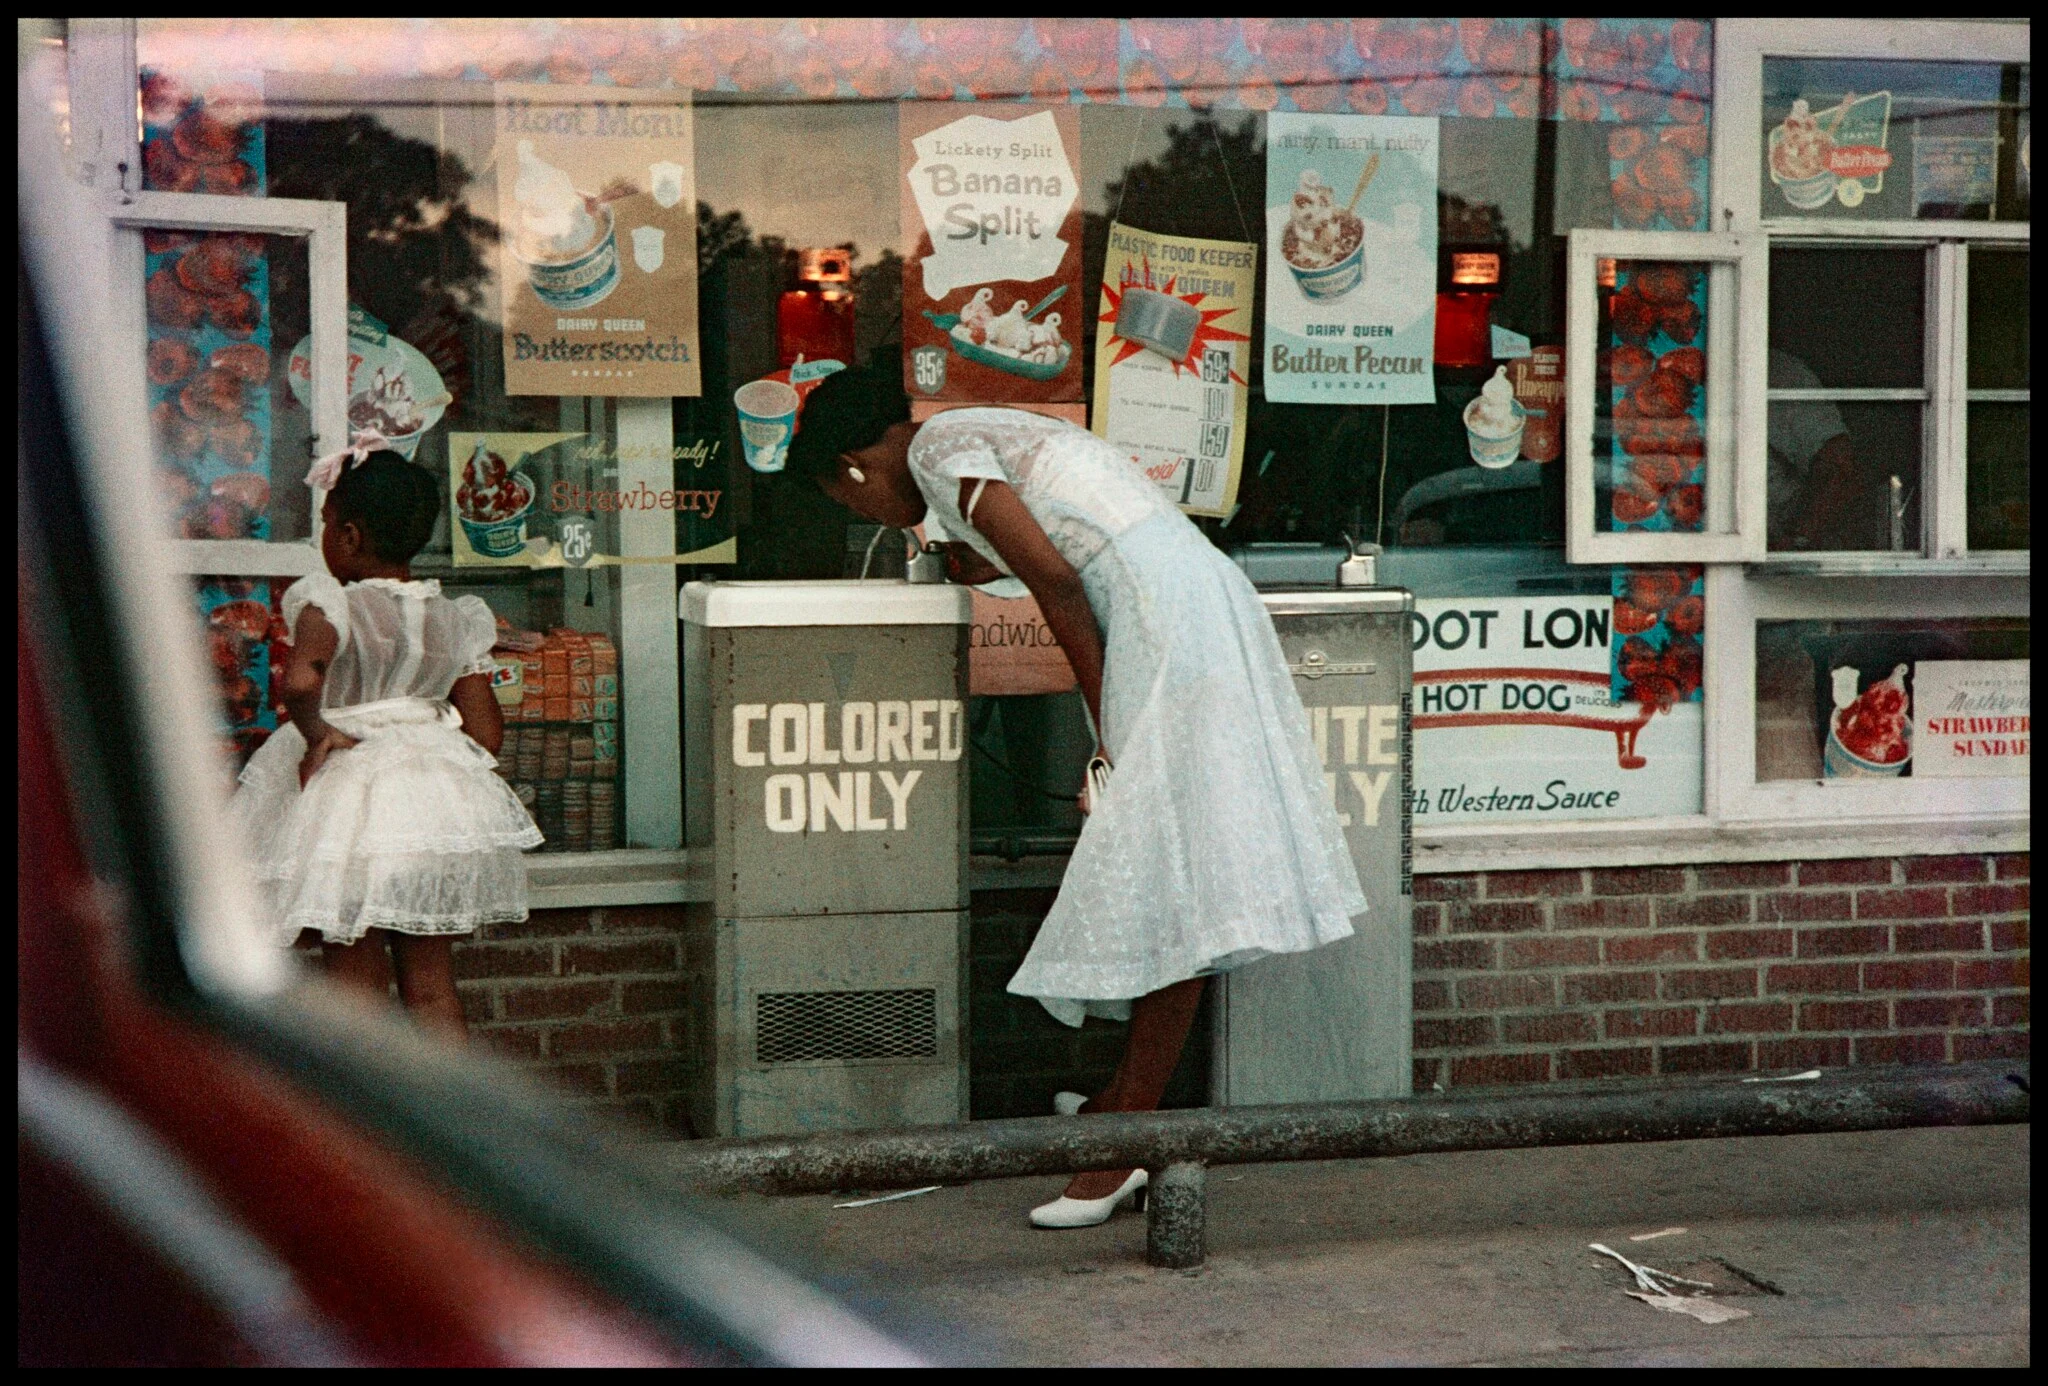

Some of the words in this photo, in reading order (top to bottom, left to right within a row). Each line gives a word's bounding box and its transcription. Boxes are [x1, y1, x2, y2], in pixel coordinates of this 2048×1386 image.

[935, 141, 1004, 160] Lickety
[1009, 142, 1053, 160] Split
[923, 163, 1062, 197] Banana
[945, 203, 1041, 245] Split
[1111, 232, 1158, 259] PLASTIC
[1162, 244, 1196, 263] FOOD
[1201, 248, 1254, 269] KEEPER
[1177, 277, 1236, 298] QUEEN
[556, 318, 598, 331] DAIRY
[603, 318, 646, 332] QUEEN
[1306, 324, 1346, 337] DAIRY
[1353, 325, 1394, 338] QUEEN
[513, 332, 691, 363] Butterscotch
[1271, 343, 1350, 374] Butter
[1354, 345, 1426, 375] Pecan
[550, 480, 723, 519] Strawberry
[562, 522, 593, 559] 25¢
[1422, 684, 1488, 713] HOT
[1502, 683, 1572, 712] DOG
[732, 699, 965, 767] COLORED
[765, 770, 923, 833] ONLY
[1438, 784, 1534, 812] Western
[1536, 780, 1620, 811] Sauce
